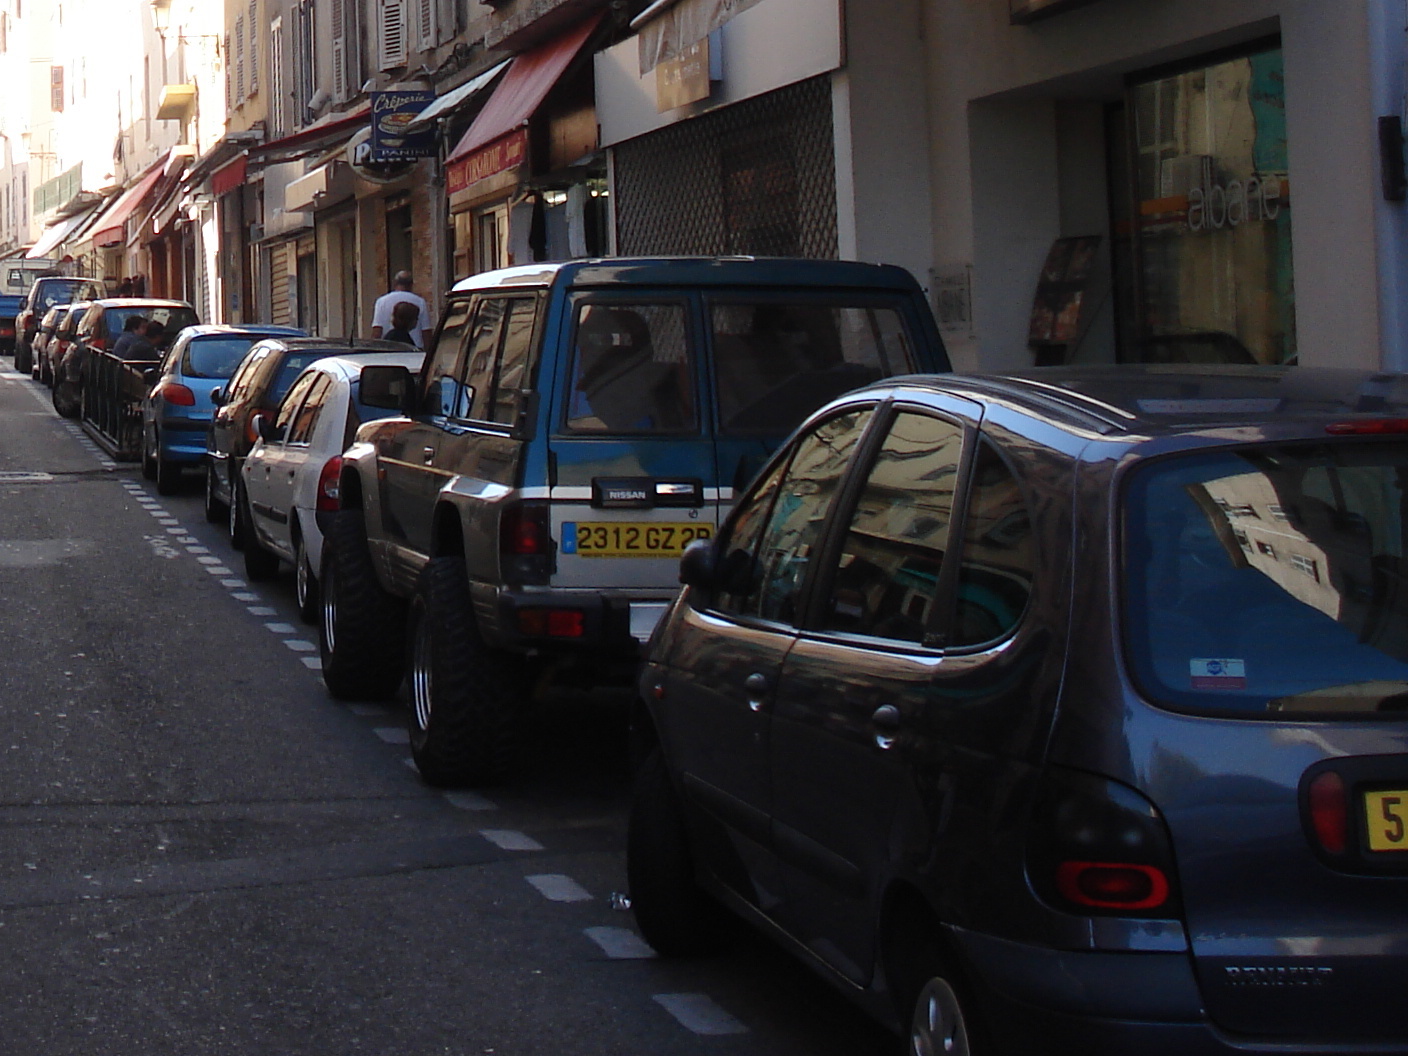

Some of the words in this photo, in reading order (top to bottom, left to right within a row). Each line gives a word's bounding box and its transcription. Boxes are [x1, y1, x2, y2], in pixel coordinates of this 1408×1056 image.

[1188, 157, 1281, 231] albane
[609, 490, 646, 500] NISSAN
[578, 527, 640, 549] 2312
[646, 527, 675, 549] GZ
[1381, 796, 1405, 843] 5
